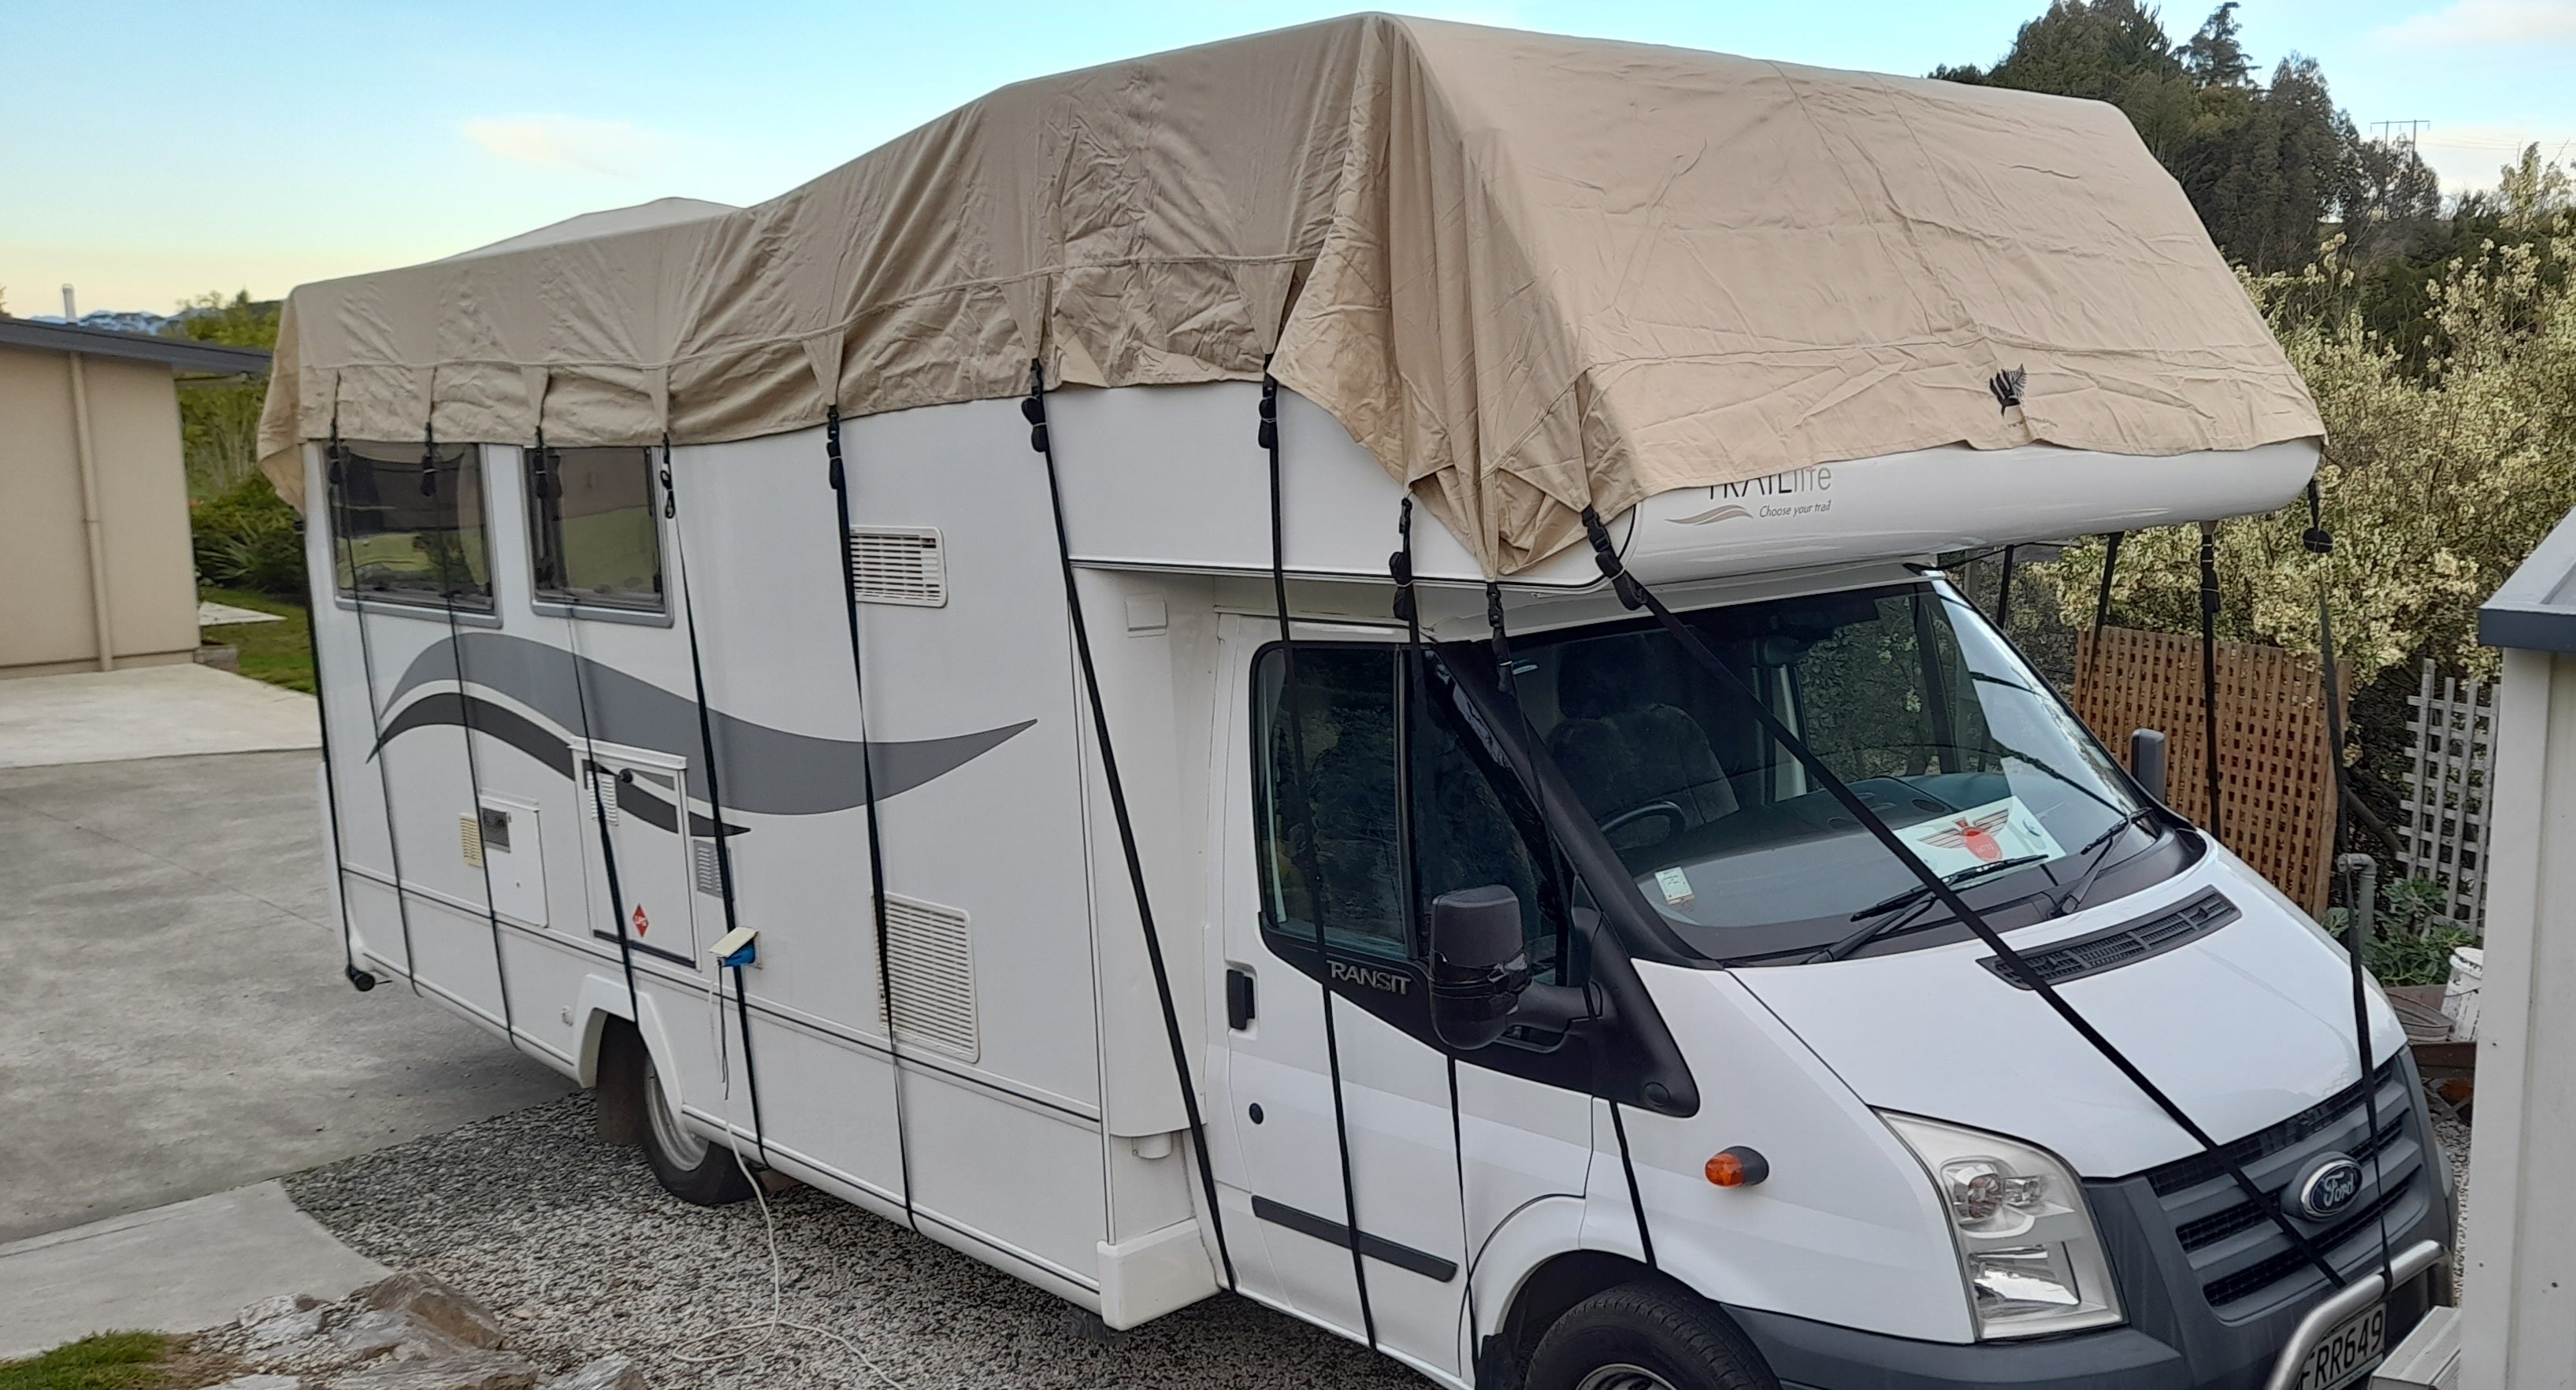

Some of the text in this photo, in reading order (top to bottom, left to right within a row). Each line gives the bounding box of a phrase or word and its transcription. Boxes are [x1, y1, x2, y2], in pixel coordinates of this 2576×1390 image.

[1759, 499, 1832, 518] Choose your trail
[1326, 959, 1412, 995] TRANSIT
[2323, 1171, 2355, 1207] Ford
